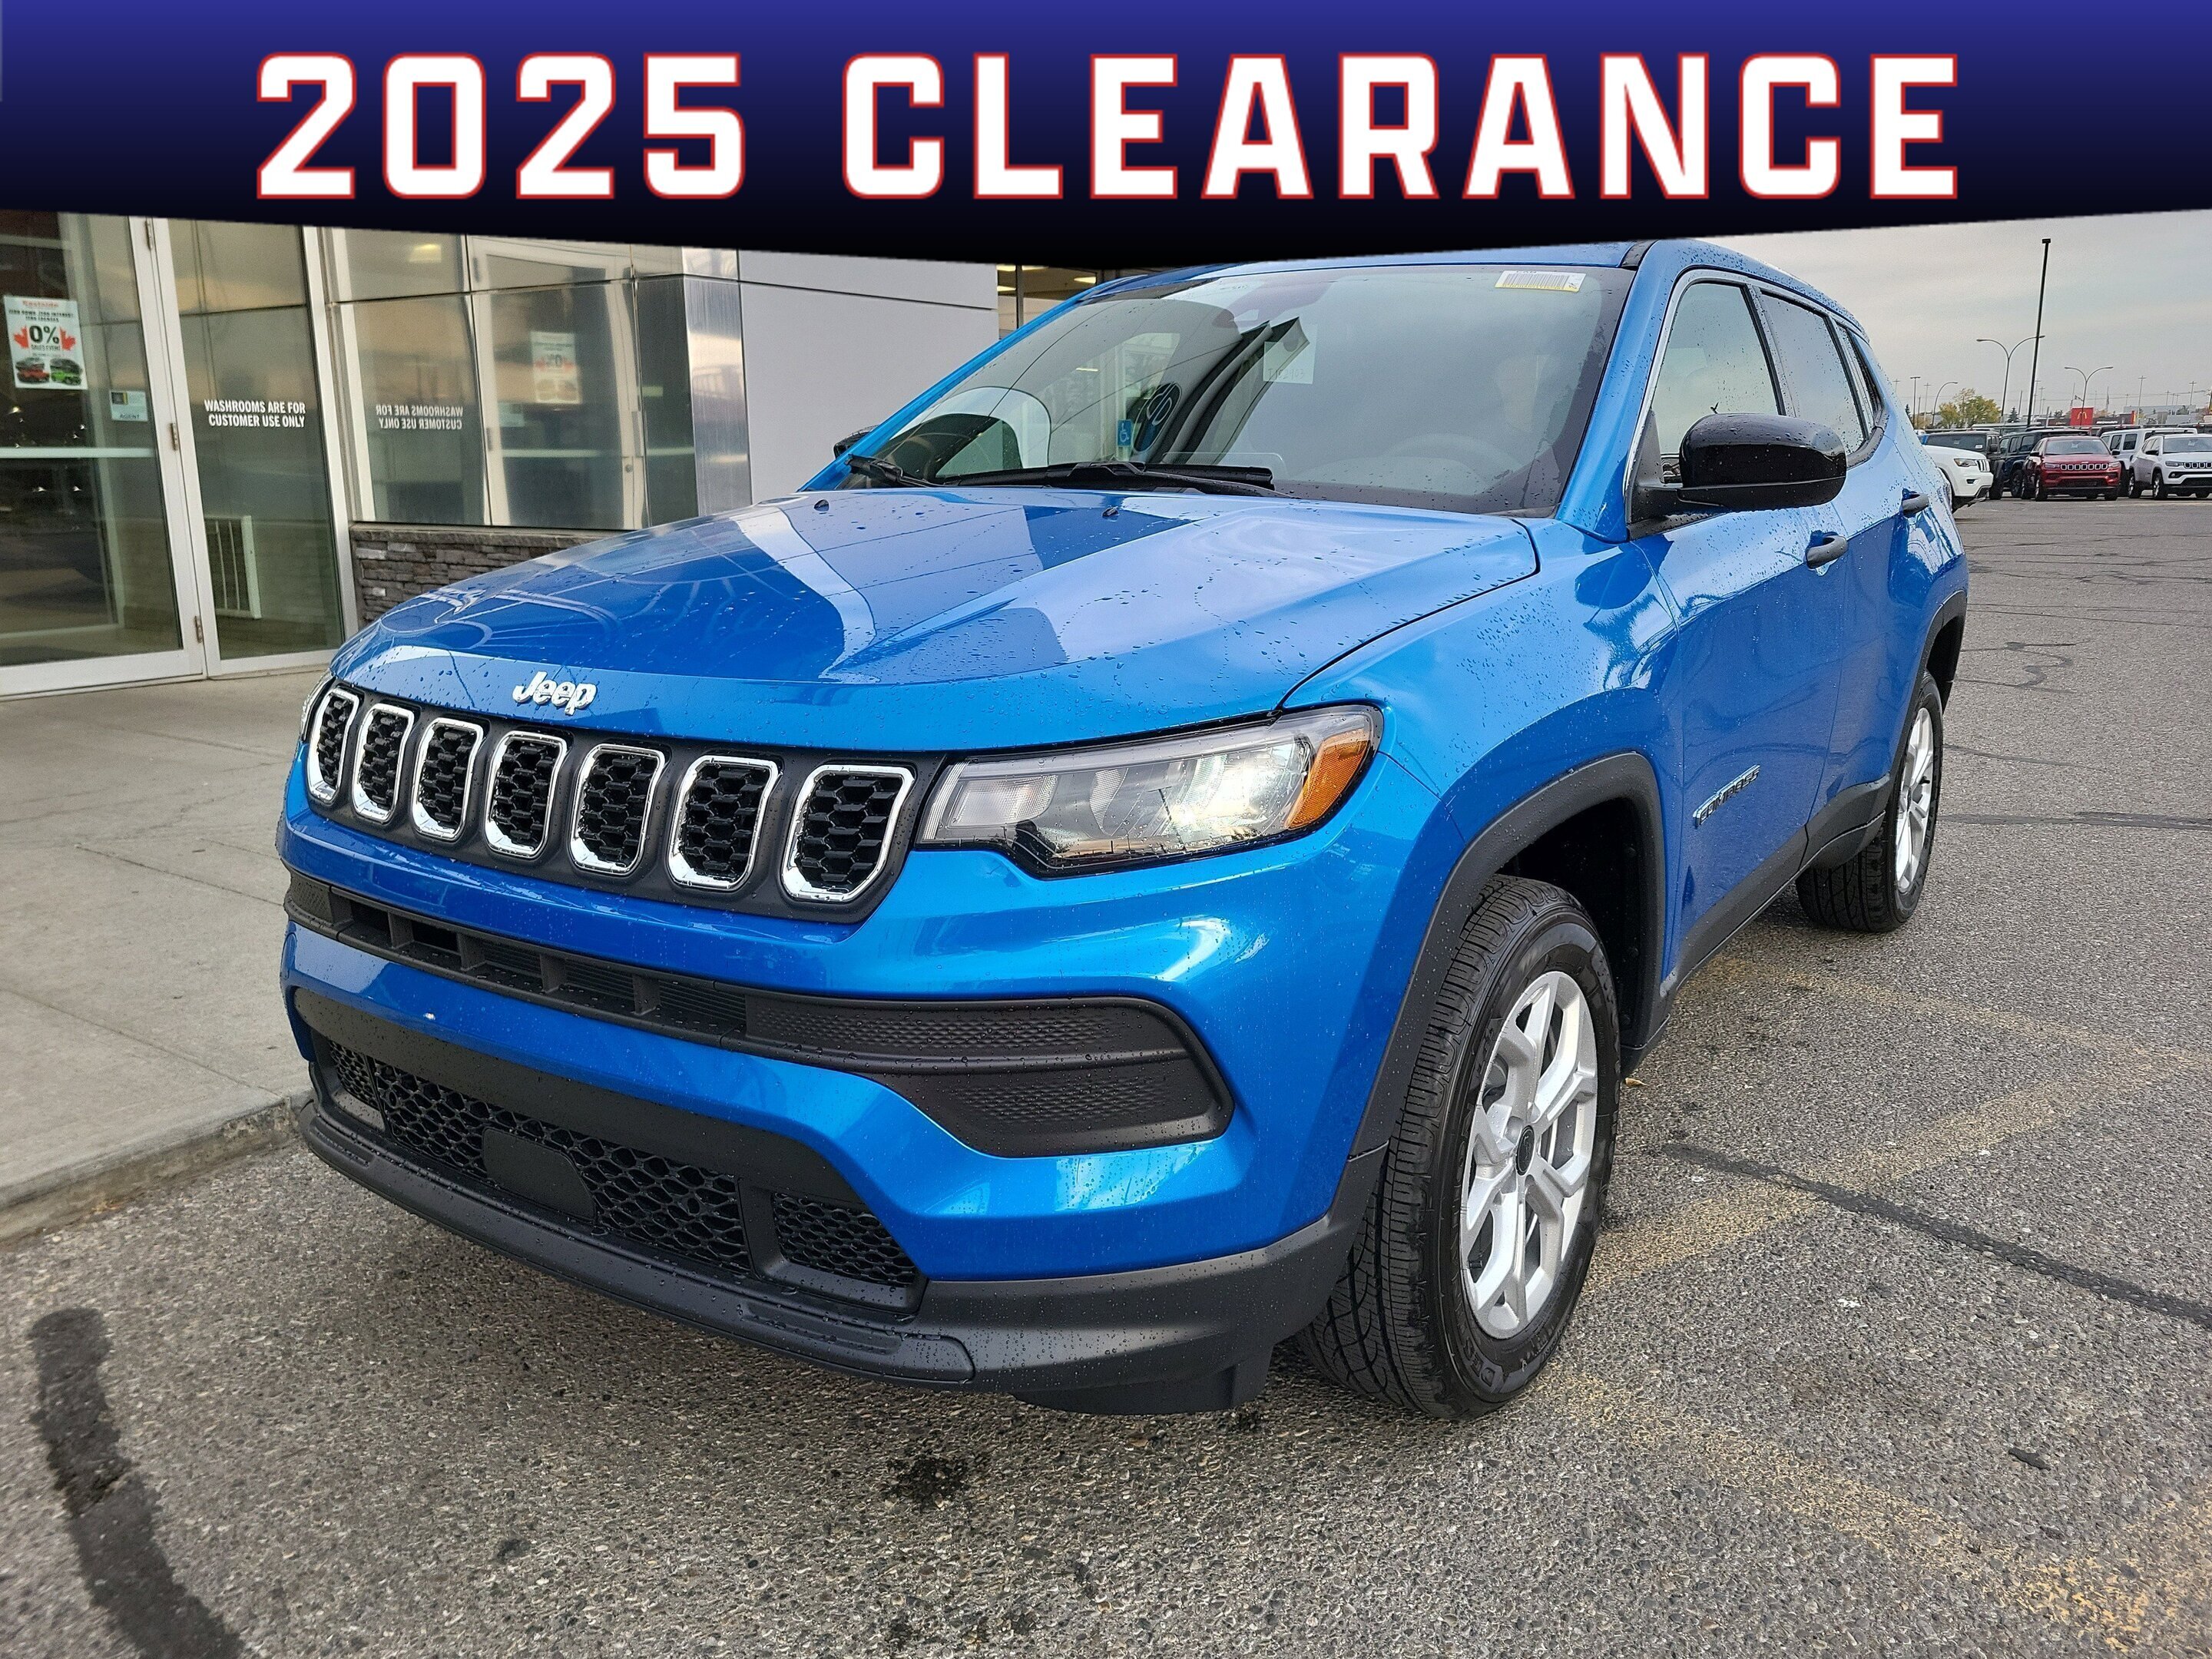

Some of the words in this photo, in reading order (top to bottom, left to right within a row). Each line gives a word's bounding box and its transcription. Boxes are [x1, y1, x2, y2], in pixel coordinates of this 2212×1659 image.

[29, 325, 60, 344] 0%
[204, 399, 266, 413] WASHROOMS
[267, 400, 286, 414] ARE
[287, 401, 306, 414] FOR
[208, 414, 260, 427] CUSTOMER
[262, 415, 280, 427] USE
[282, 415, 305, 428] ONLY
[512, 671, 597, 716] Jeep
